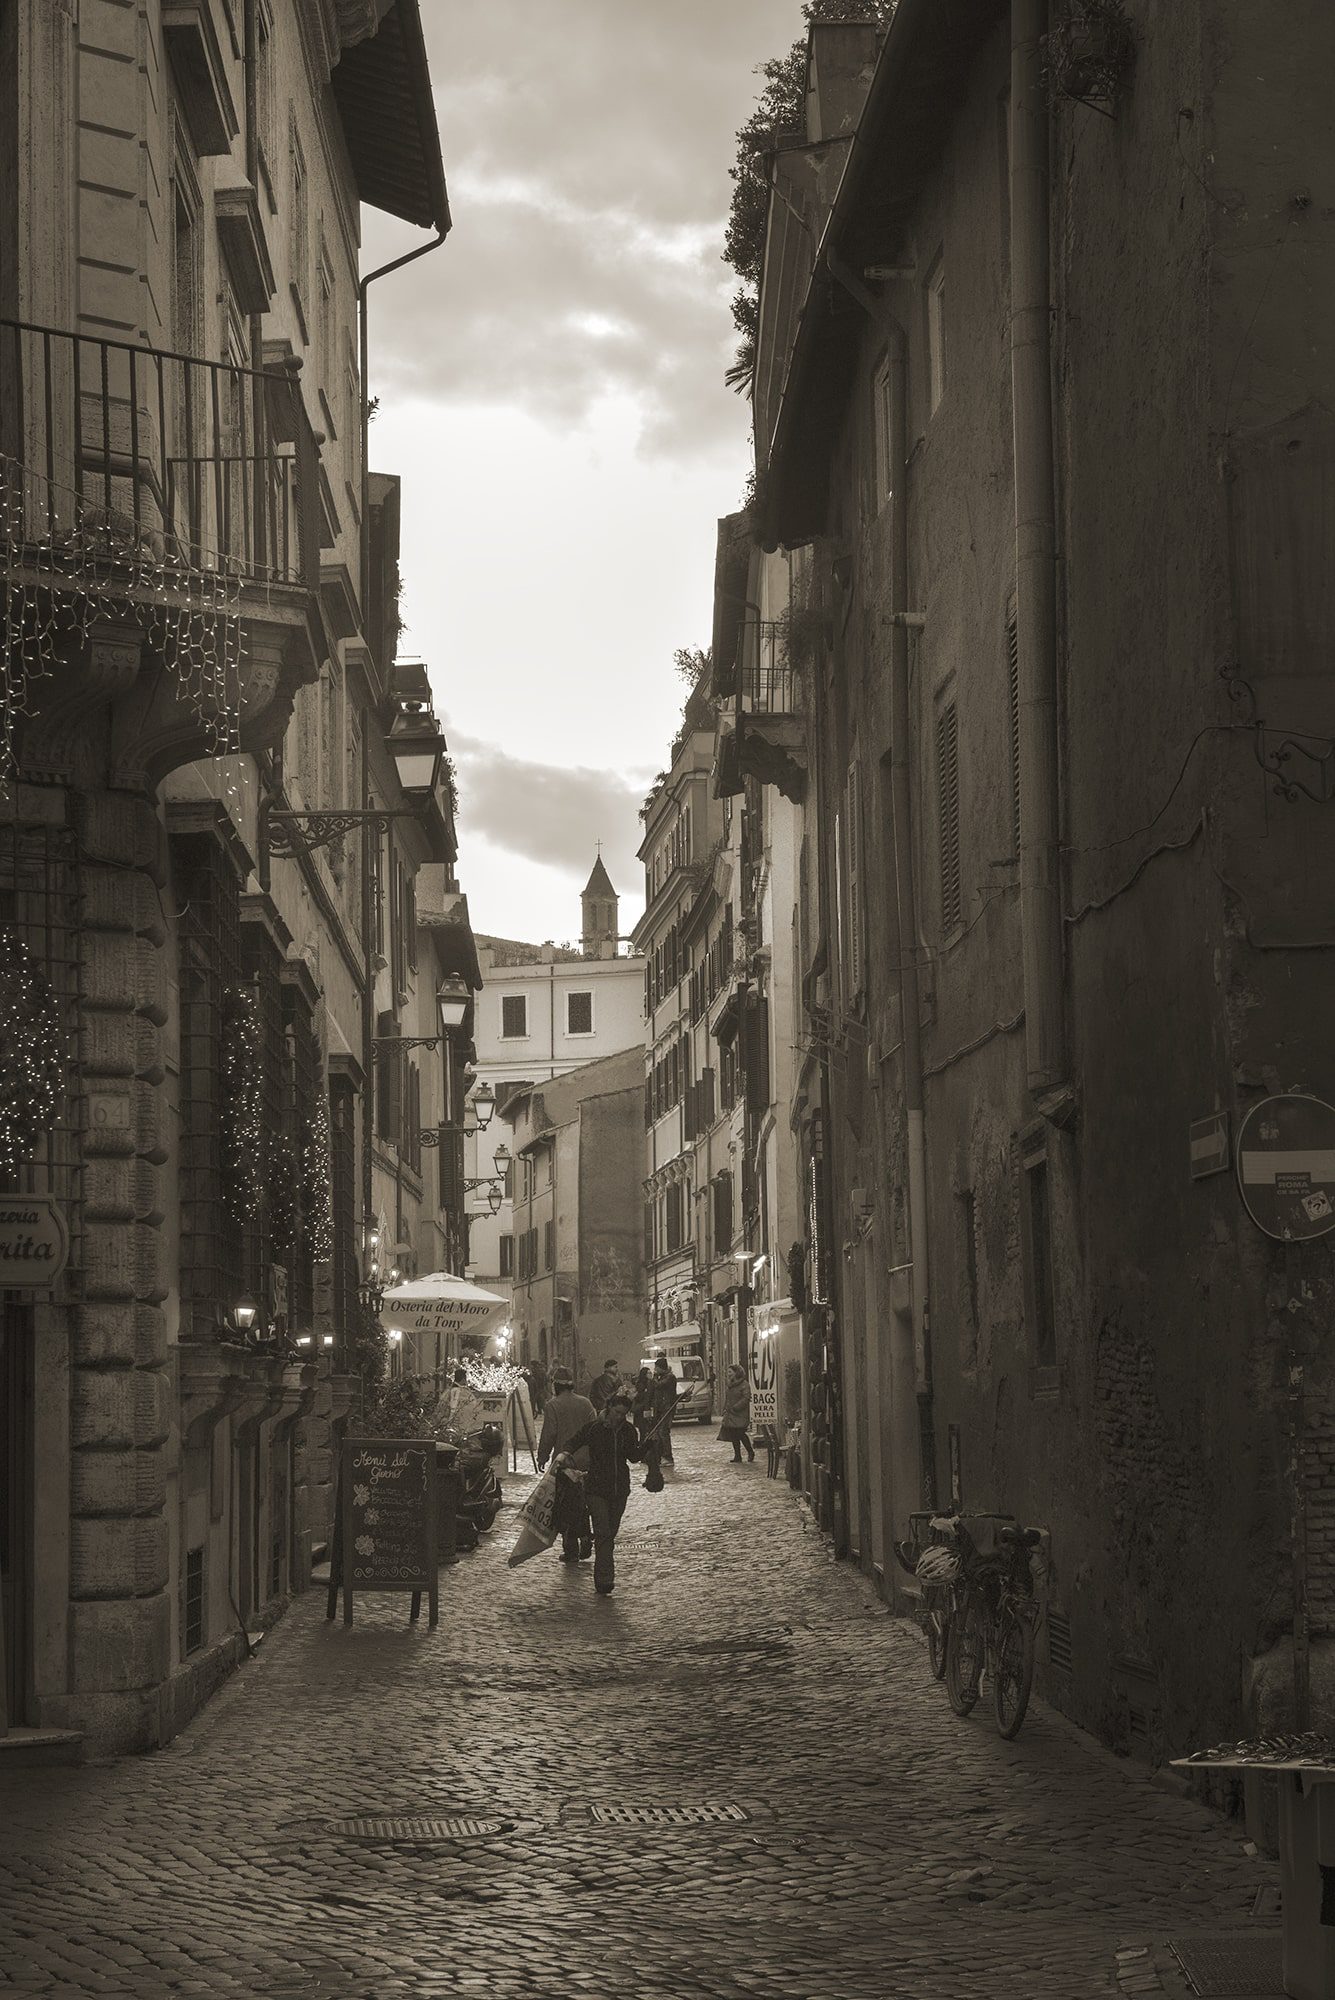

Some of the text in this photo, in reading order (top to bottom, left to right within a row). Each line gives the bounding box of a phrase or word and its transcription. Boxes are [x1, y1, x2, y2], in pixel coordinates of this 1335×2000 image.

[94, 1098, 123, 1124] 64
[390, 1300, 490, 1316] Osteria del Moro
[415, 1315, 464, 1331] da Tony
[753, 1393, 776, 1404] BAGS
[391, 1452, 410, 1467] del
